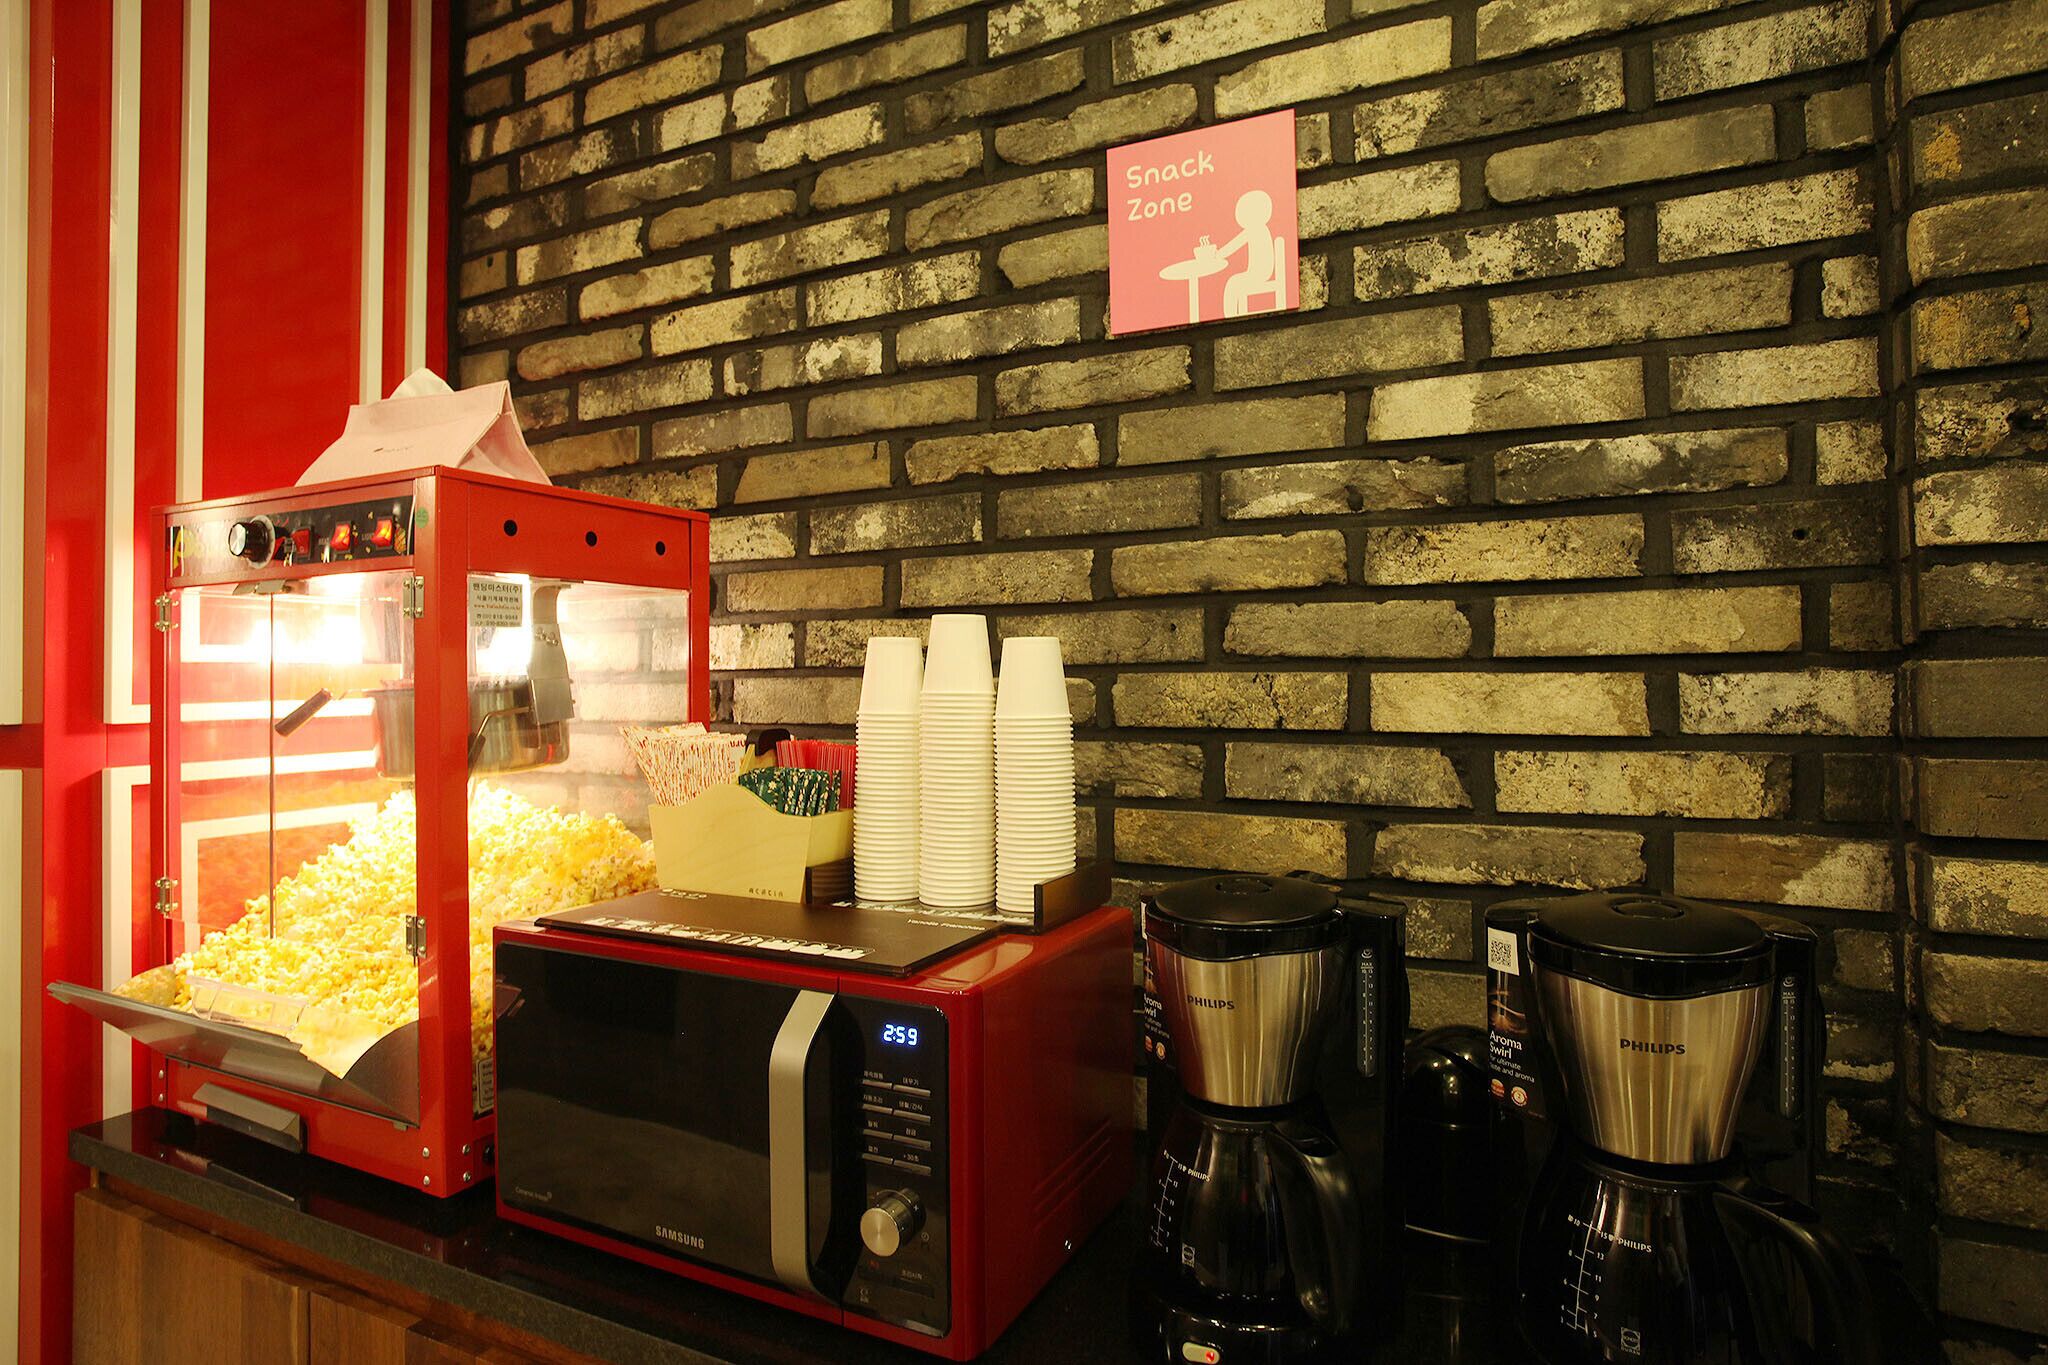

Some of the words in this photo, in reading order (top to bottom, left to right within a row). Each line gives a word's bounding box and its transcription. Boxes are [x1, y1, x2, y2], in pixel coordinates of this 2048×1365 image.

[1126, 150, 1215, 188] Snack
[1127, 192, 1193, 221] Zone
[1187, 994, 1235, 1010] PHILIPS
[883, 1023, 918, 1046] 2:59
[1489, 1030, 1523, 1051] Aroma
[1489, 1041, 1513, 1059] Swirl
[1620, 1038, 1686, 1055] PHILIPS
[1497, 1056, 1522, 1071] ultimate
[655, 1224, 705, 1251] SAMSUNG
[1617, 1237, 1653, 1254] PHILIPS
